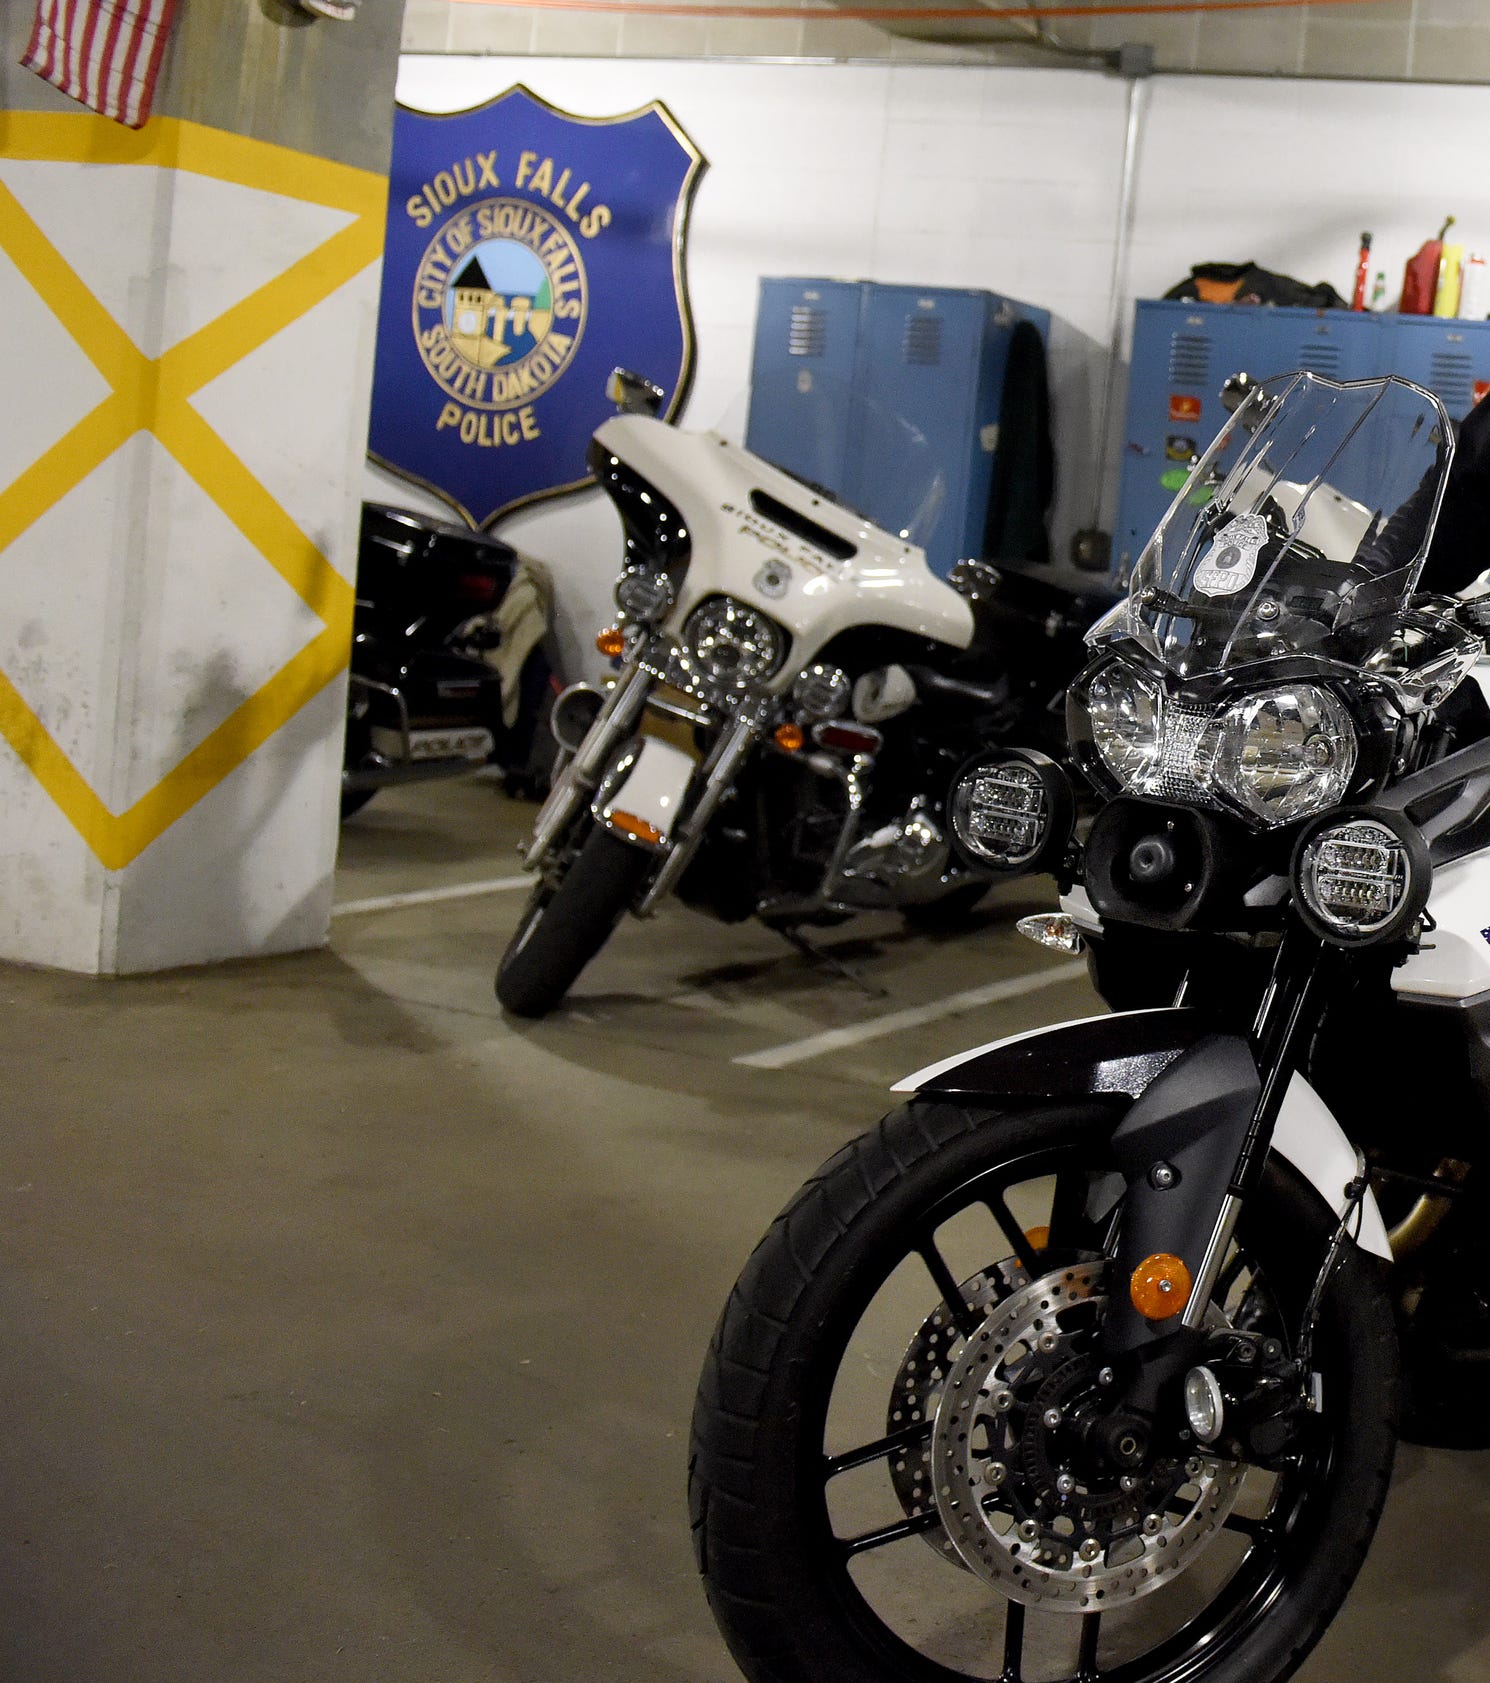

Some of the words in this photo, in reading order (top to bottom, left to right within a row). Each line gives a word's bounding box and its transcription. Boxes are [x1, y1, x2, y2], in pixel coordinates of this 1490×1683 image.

[405, 150, 500, 229] SIOUX
[514, 150, 612, 240] FALLS
[418, 243, 453, 310] CITY
[446, 216, 476, 252] OF
[478, 205, 547, 247] SIOUX
[543, 232, 582, 320] FALLS
[420, 325, 485, 401] SOUTH
[491, 332, 573, 402] DAKOTA
[436, 401, 541, 448] POLICE
